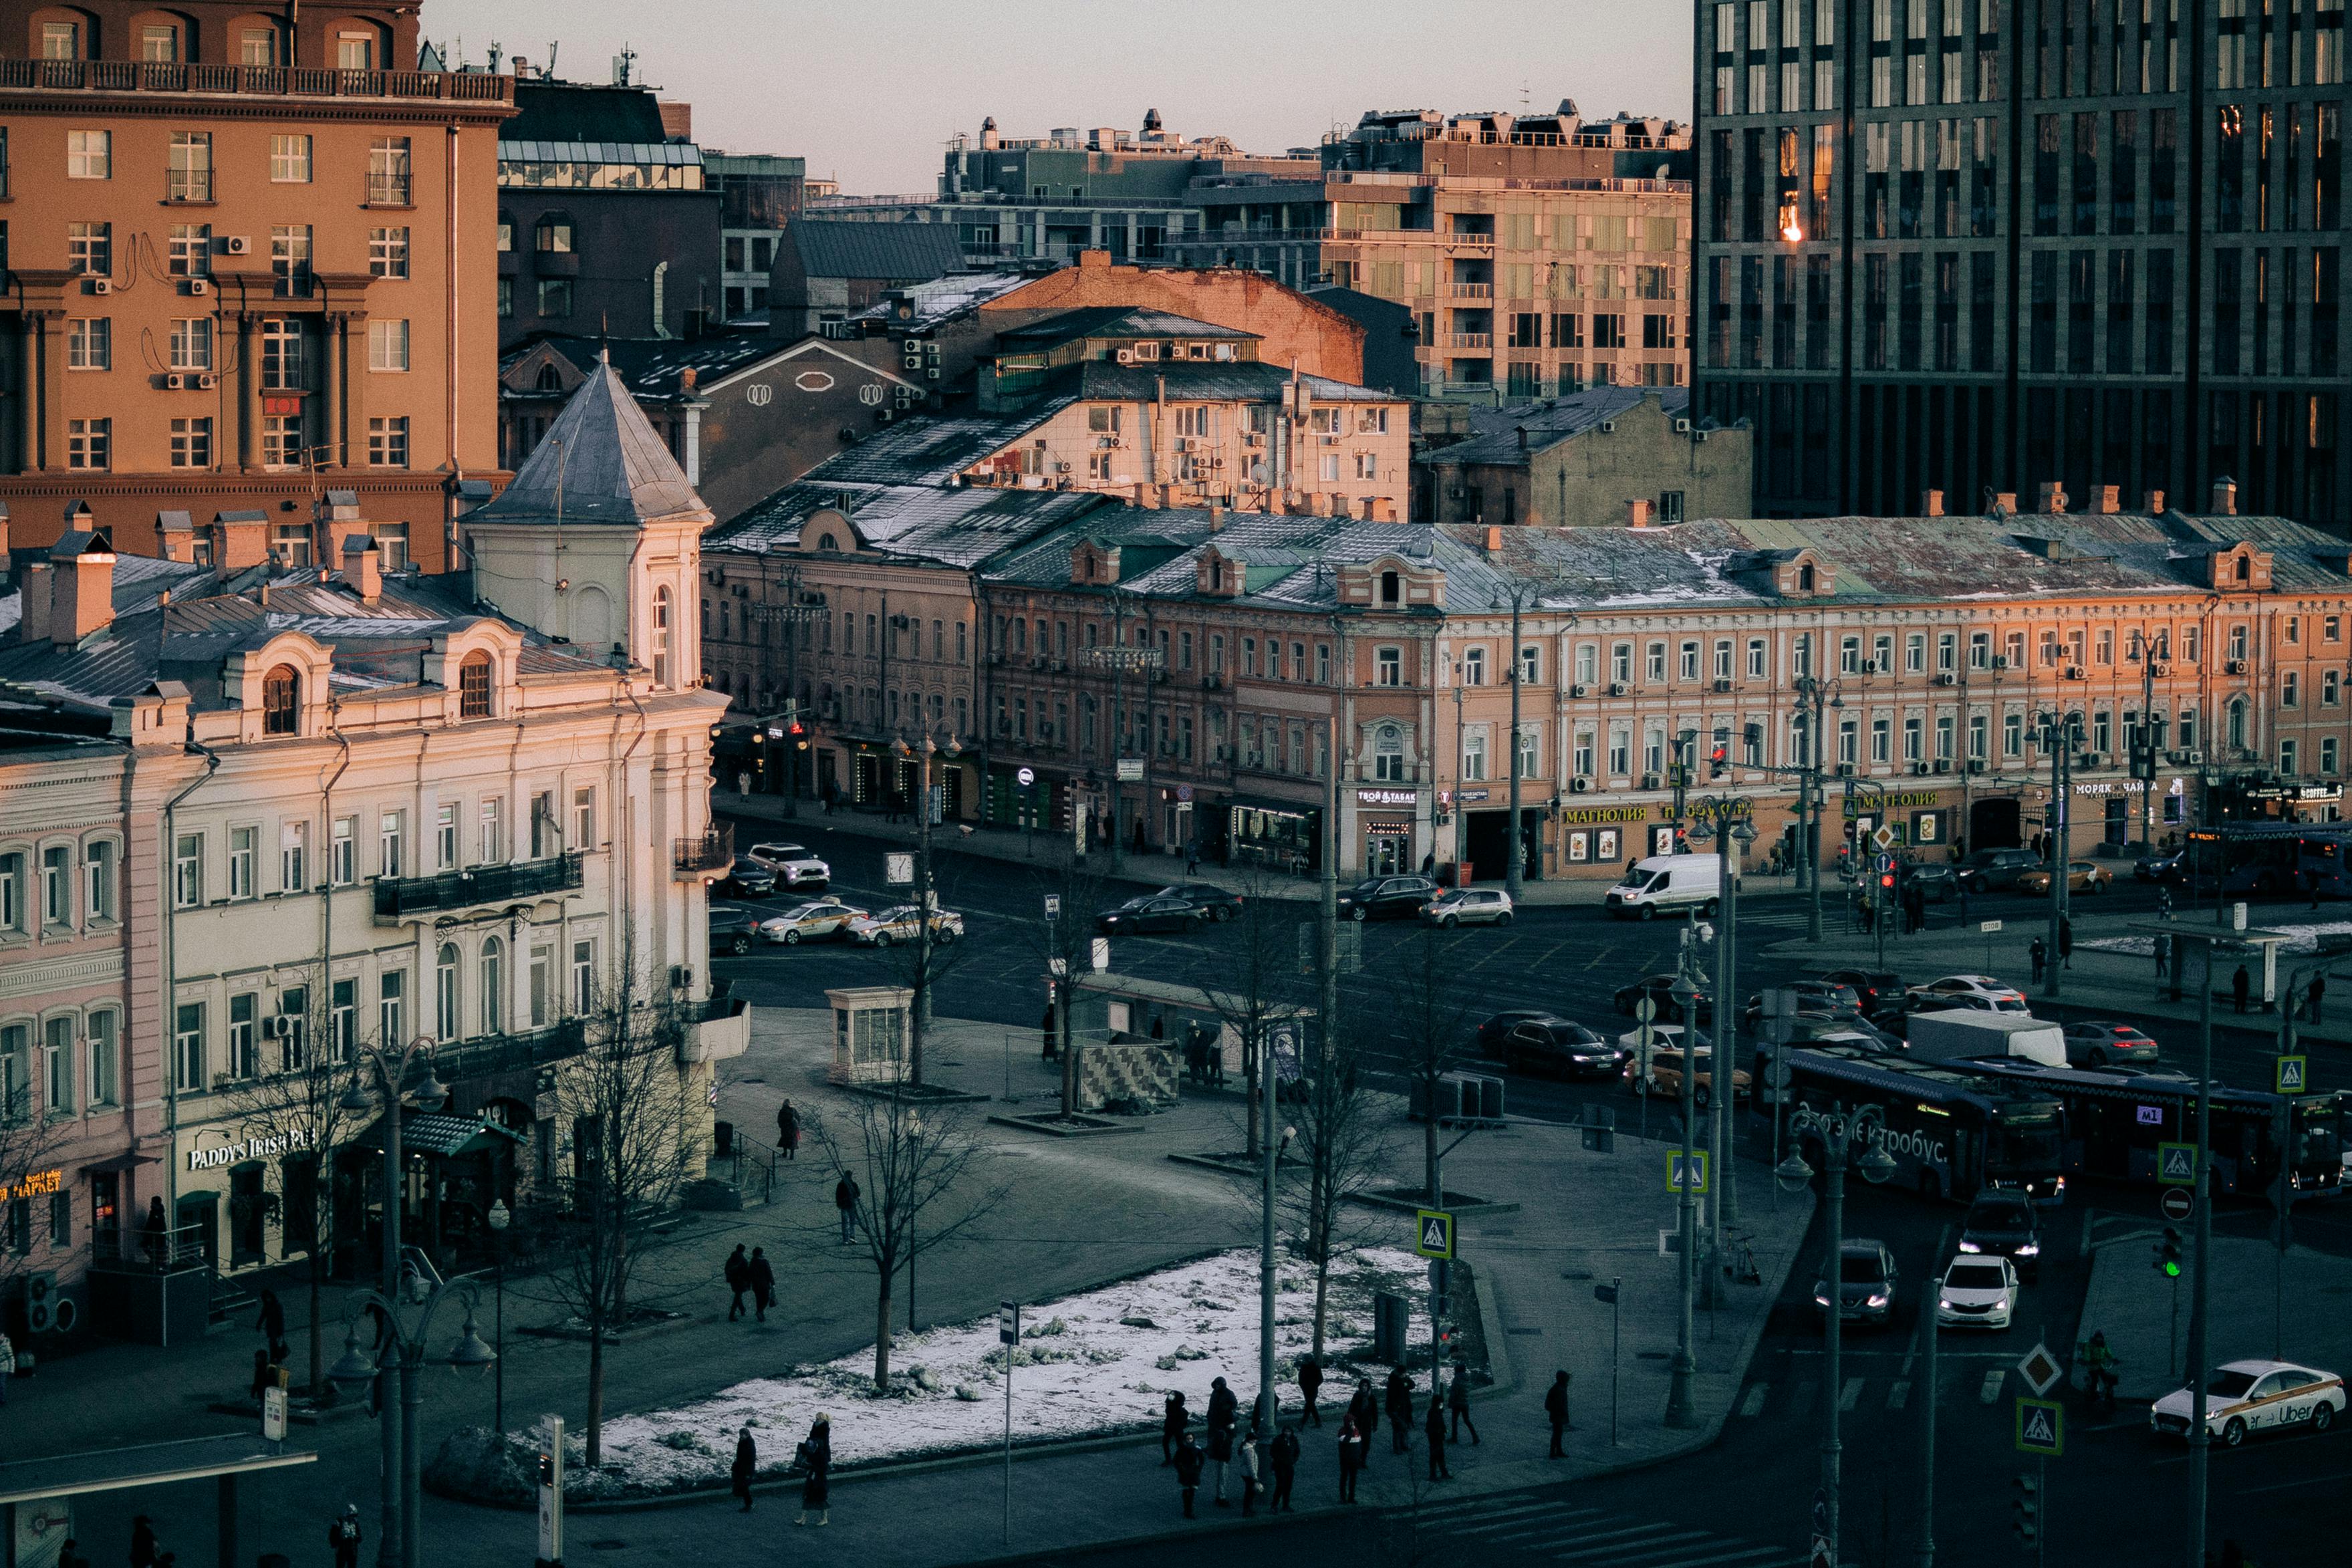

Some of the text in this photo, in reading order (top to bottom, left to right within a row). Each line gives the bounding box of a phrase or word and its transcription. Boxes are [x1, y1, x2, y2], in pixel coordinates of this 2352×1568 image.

[2075, 784, 2111, 794] МОРЯК
[2123, 779, 2158, 792] ЧАЙА
[2306, 787, 2328, 799] COFFEE
[1358, 791, 1416, 801] ТВОЙ ТАБАК
[1565, 807, 1647, 823] МАГНОЛИЯ
[2279, 1406, 2311, 1423] Uber
